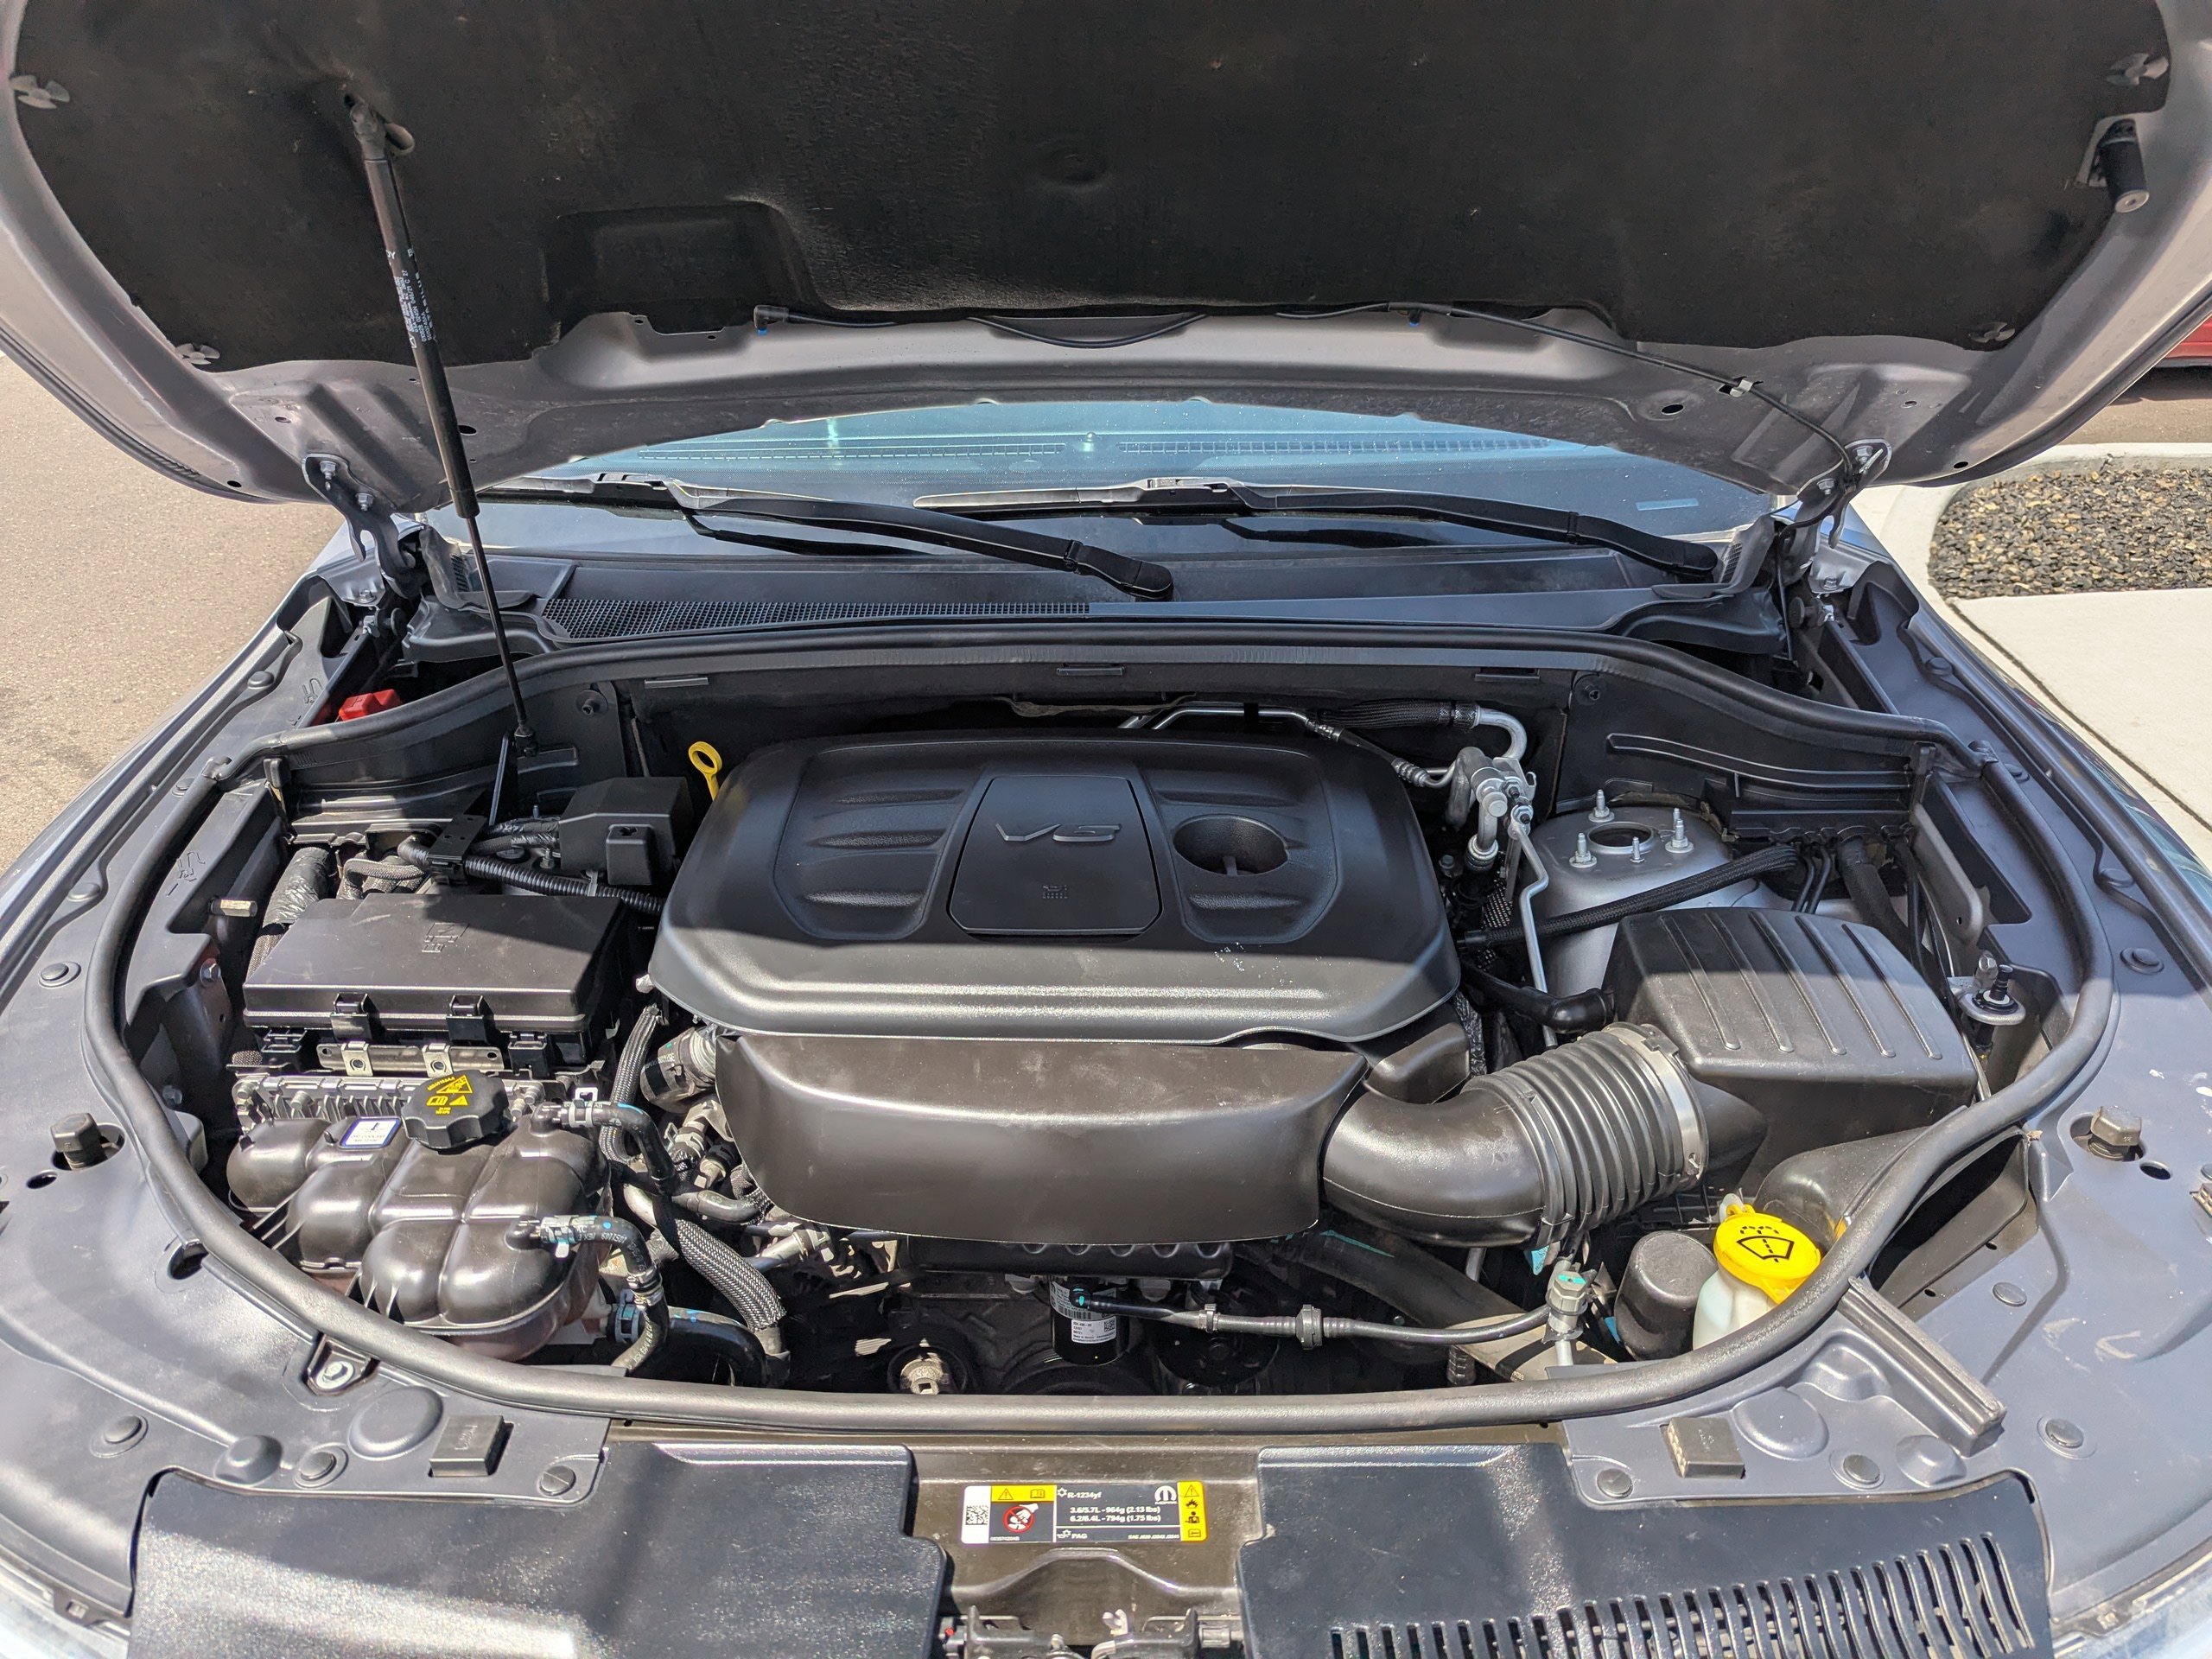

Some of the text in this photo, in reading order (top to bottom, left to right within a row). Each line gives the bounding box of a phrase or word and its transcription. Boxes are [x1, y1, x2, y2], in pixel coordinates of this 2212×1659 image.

[995, 823, 1122, 842] V6
[1067, 1491, 1103, 1500] R-1234yf
[1105, 1506, 1126, 1515] 964g
[1105, 1515, 1126, 1523] 794g
